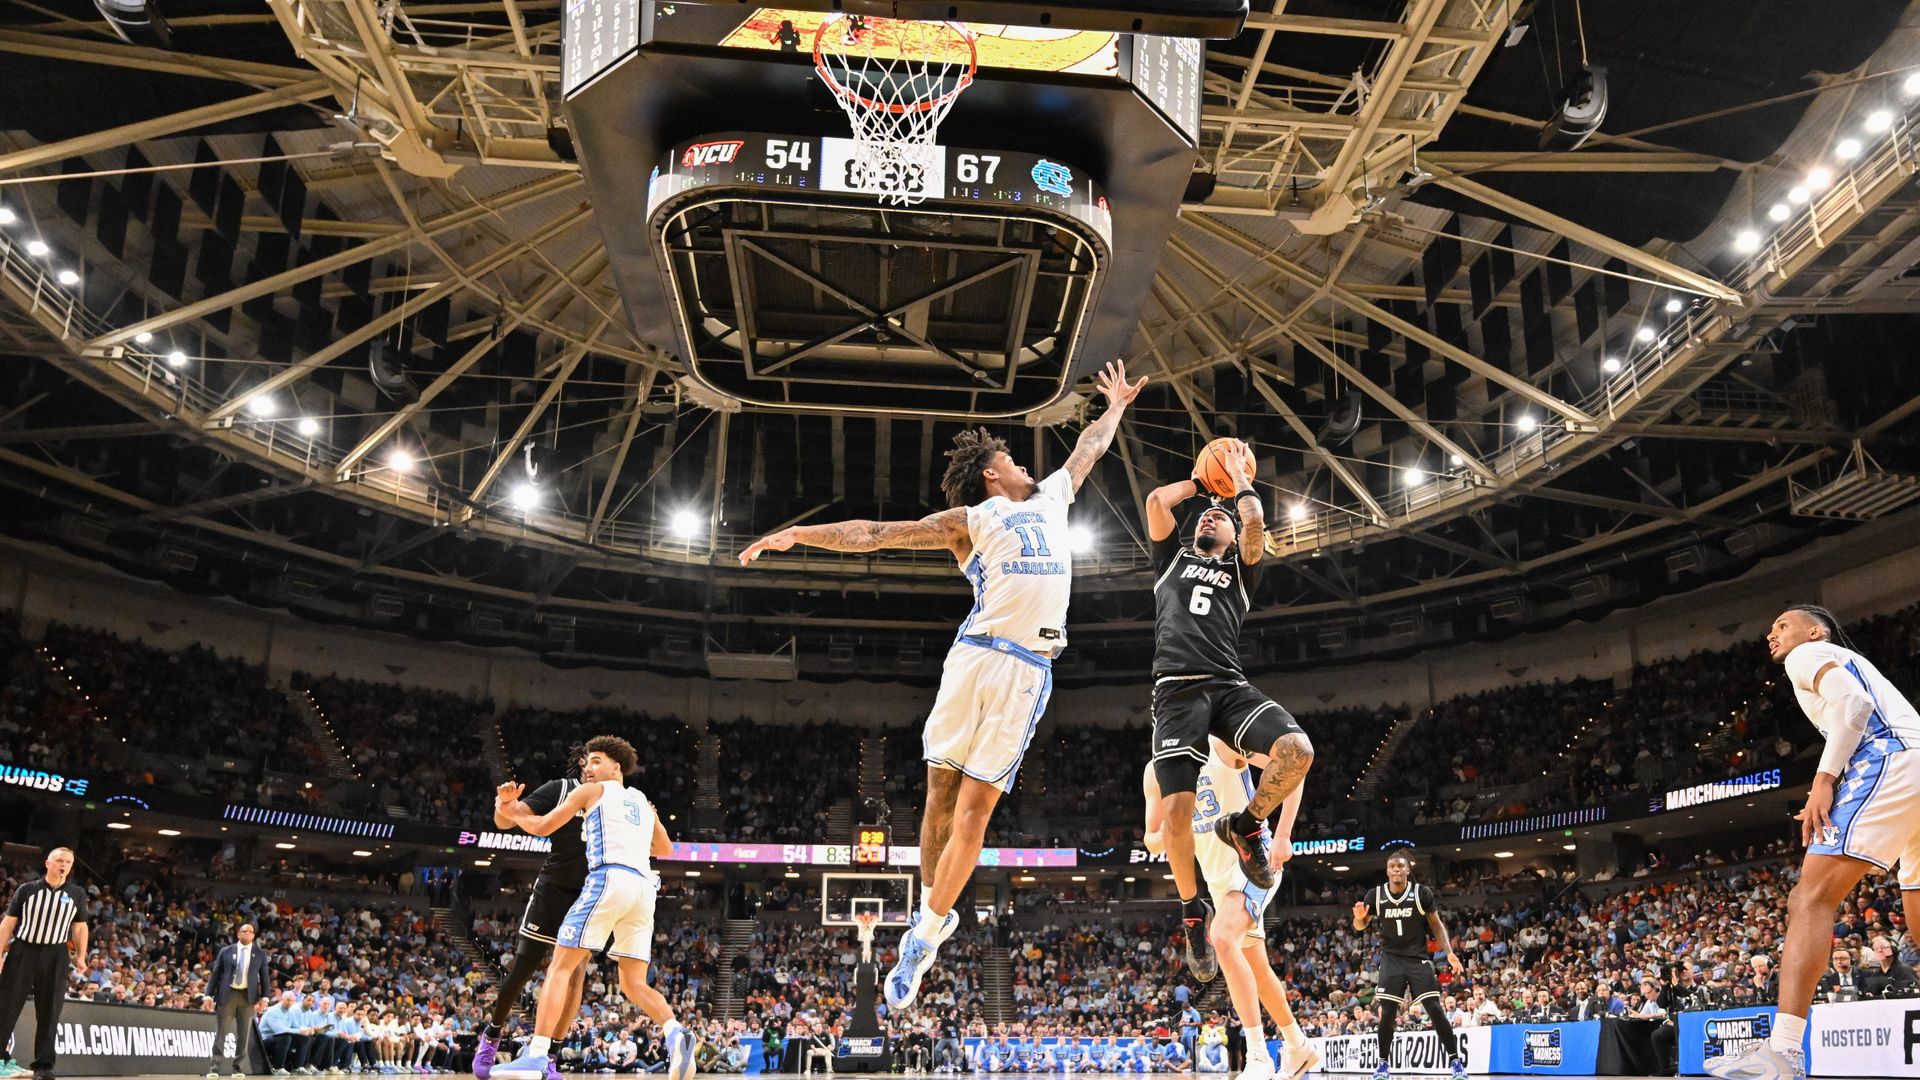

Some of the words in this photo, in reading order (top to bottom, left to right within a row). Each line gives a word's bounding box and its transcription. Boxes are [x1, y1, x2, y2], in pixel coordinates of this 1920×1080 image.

[592, 16, 603, 32] 12
[571, 45, 581, 60] 11
[692, 144, 738, 166] VCU
[766, 139, 811, 171] 54
[957, 153, 1001, 185] 67
[1002, 511, 1046, 531] NORTH
[1015, 526, 1051, 557] 11
[1001, 561, 1066, 575] CAROLINA
[1180, 564, 1232, 589] RAMS
[1189, 584, 1214, 616] 6
[1162, 738, 1180, 748] VCU
[1666, 768, 1781, 811] MARCHMADNESS
[624, 800, 640, 826] 3
[478, 832, 553, 852] MARCHMA
[1292, 839, 1347, 856] OUNDS
[783, 844, 807, 863] 54
[827, 847, 857, 862] 8:3
[889, 851, 907, 860] 2ND
[1385, 907, 1413, 918] RAMS
[527, 922, 539, 932] VCU
[1396, 920, 1402, 936] 1
[1716, 1021, 1752, 1039] MARCH
[1822, 1029, 1872, 1047] HOSTED
[1876, 1027, 1892, 1046] BY
[55, 1022, 237, 1058] CAA.COM/MARCHMADNSS
[848, 1039, 872, 1047] MARCH
[1530, 1033, 1550, 1047] MARCH
[850, 1046, 882, 1055] MADNESS
[1325, 1039, 1350, 1069] FIRST
[1359, 1037, 1403, 1069] SECND
[1404, 1032, 1469, 1069] ROUNS
[1533, 1047, 1561, 1061] MADNESS
